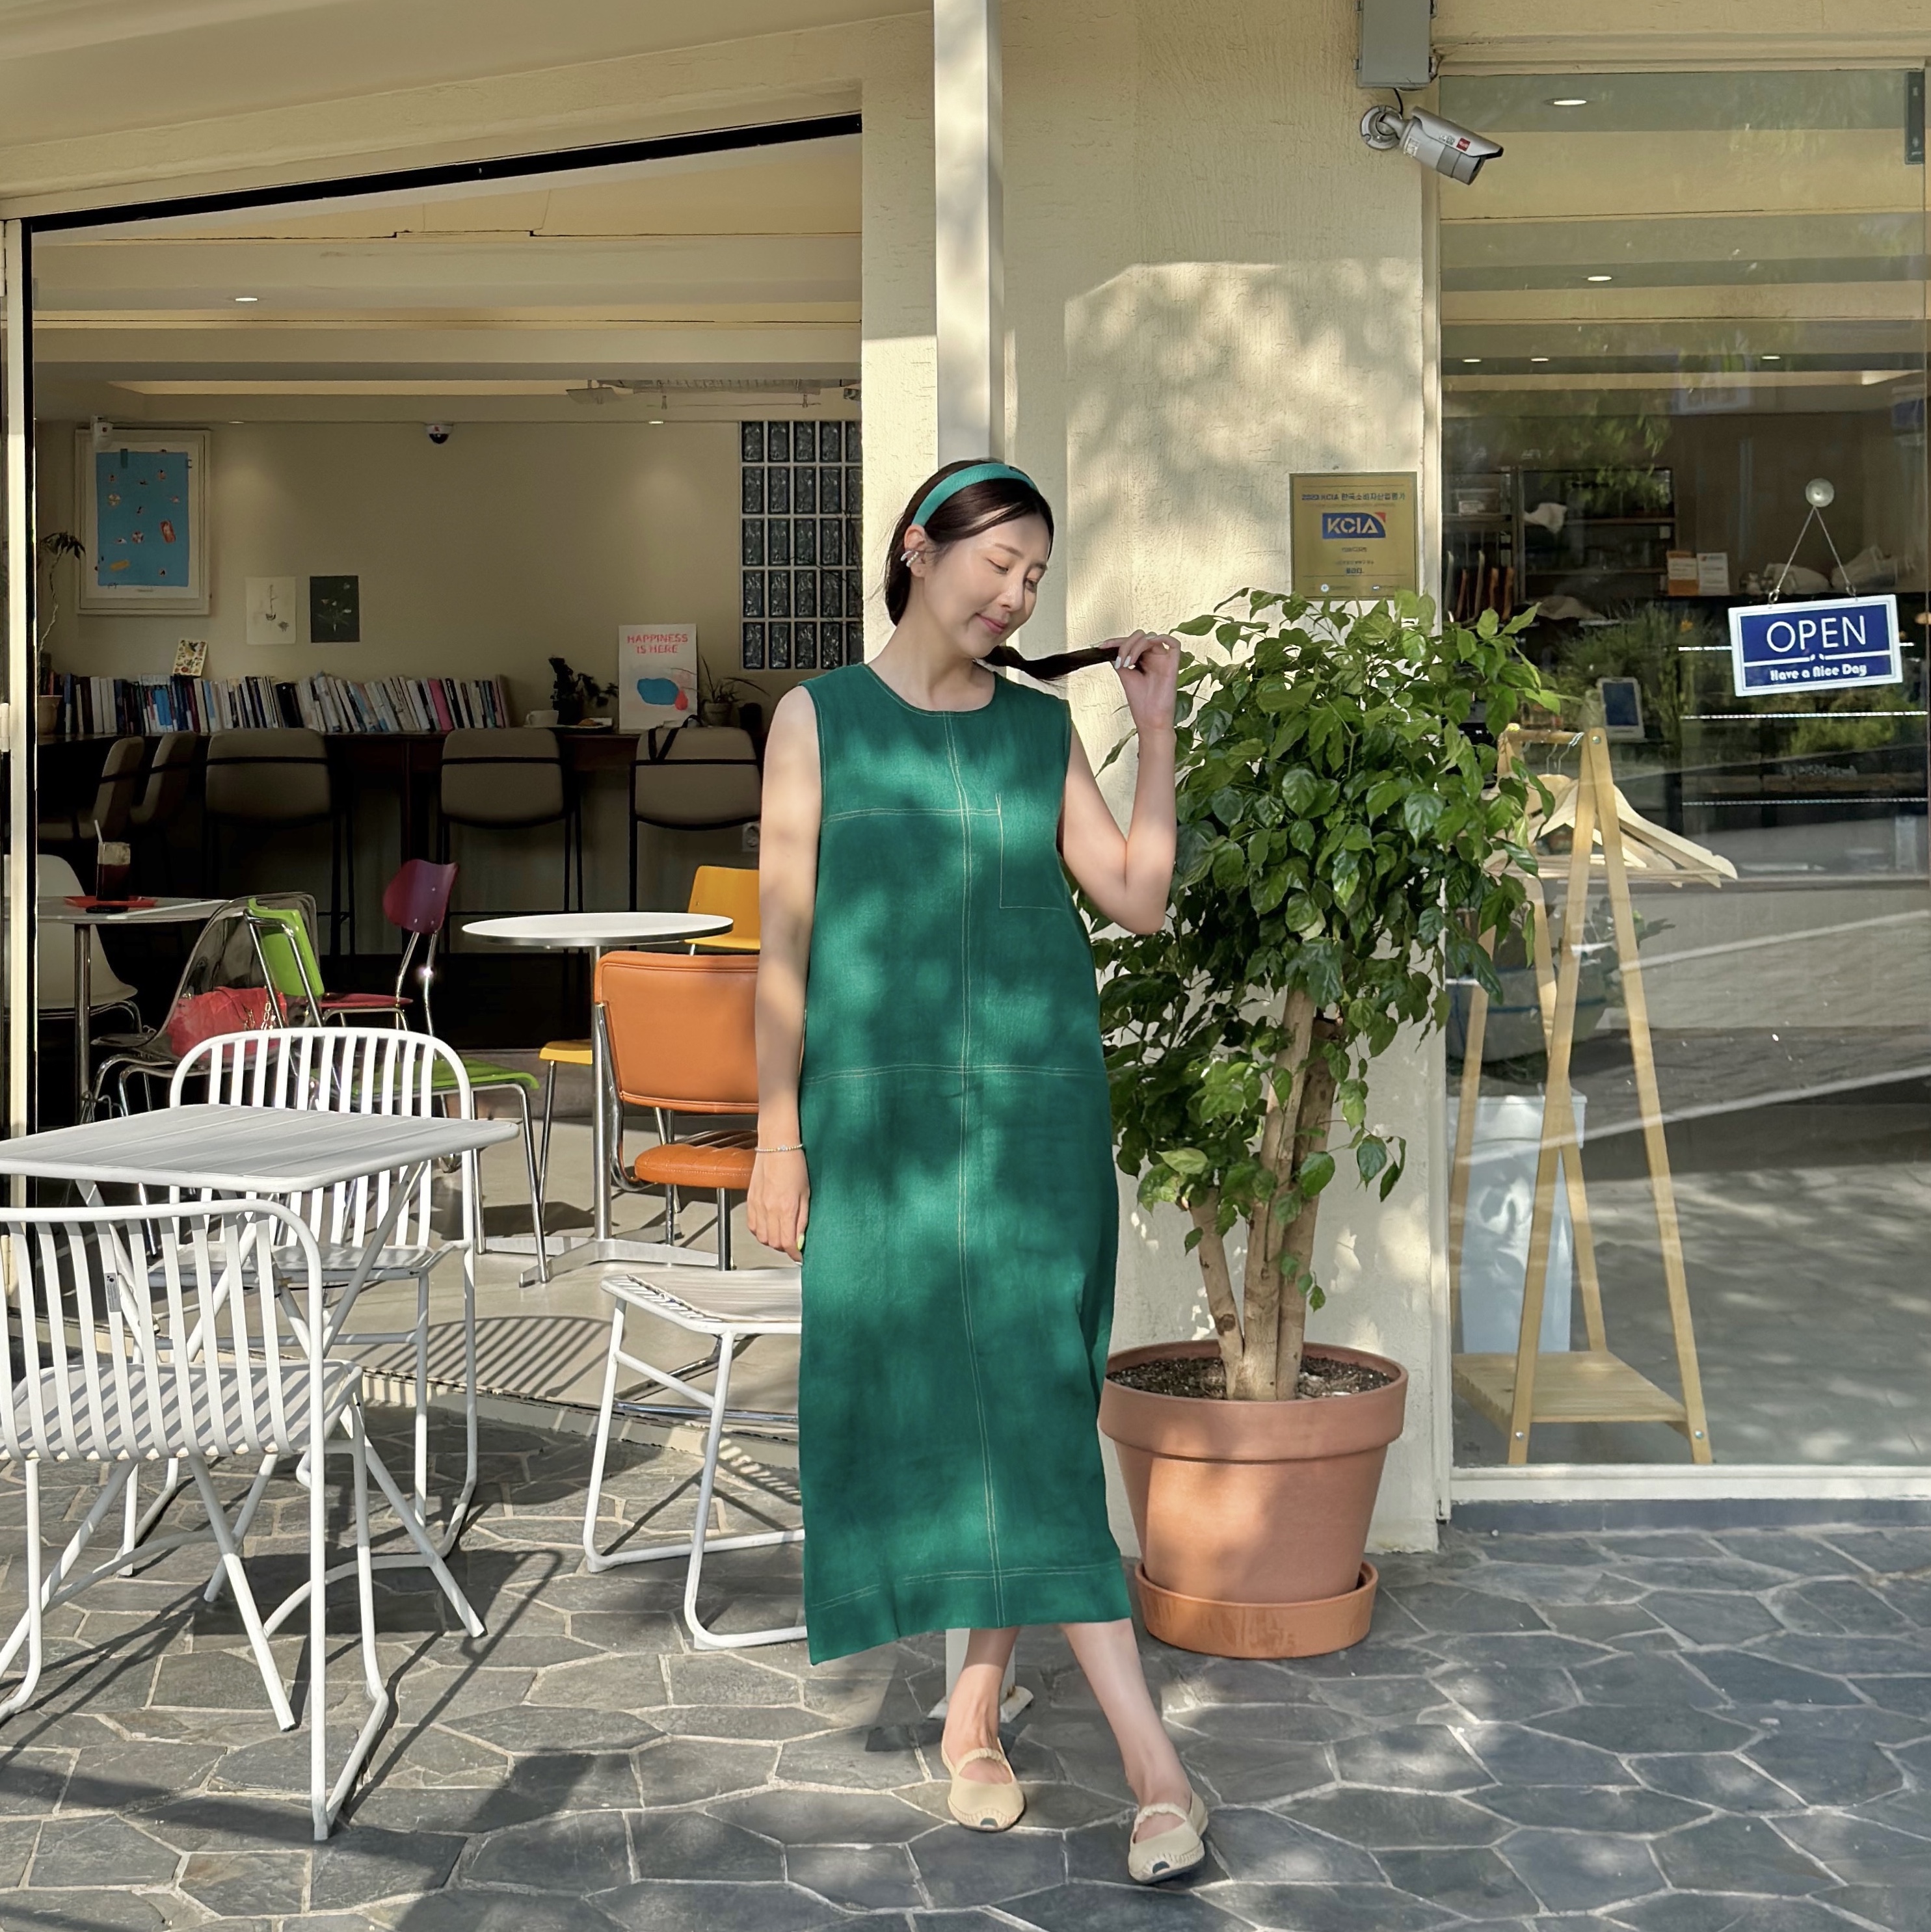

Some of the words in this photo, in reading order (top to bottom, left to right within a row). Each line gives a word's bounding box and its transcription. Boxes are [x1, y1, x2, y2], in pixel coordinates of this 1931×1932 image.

[1327, 518, 1378, 534] KCIA
[627, 633, 688, 643] HAPPINESS
[1766, 615, 1866, 652] OPEN
[637, 645, 646, 654] IS
[649, 644, 678, 654] HERE
[1770, 668, 1798, 681] Have
[1801, 669, 1810, 678] a
[1813, 665, 1839, 678] Nice
[1842, 663, 1867, 677] Day
